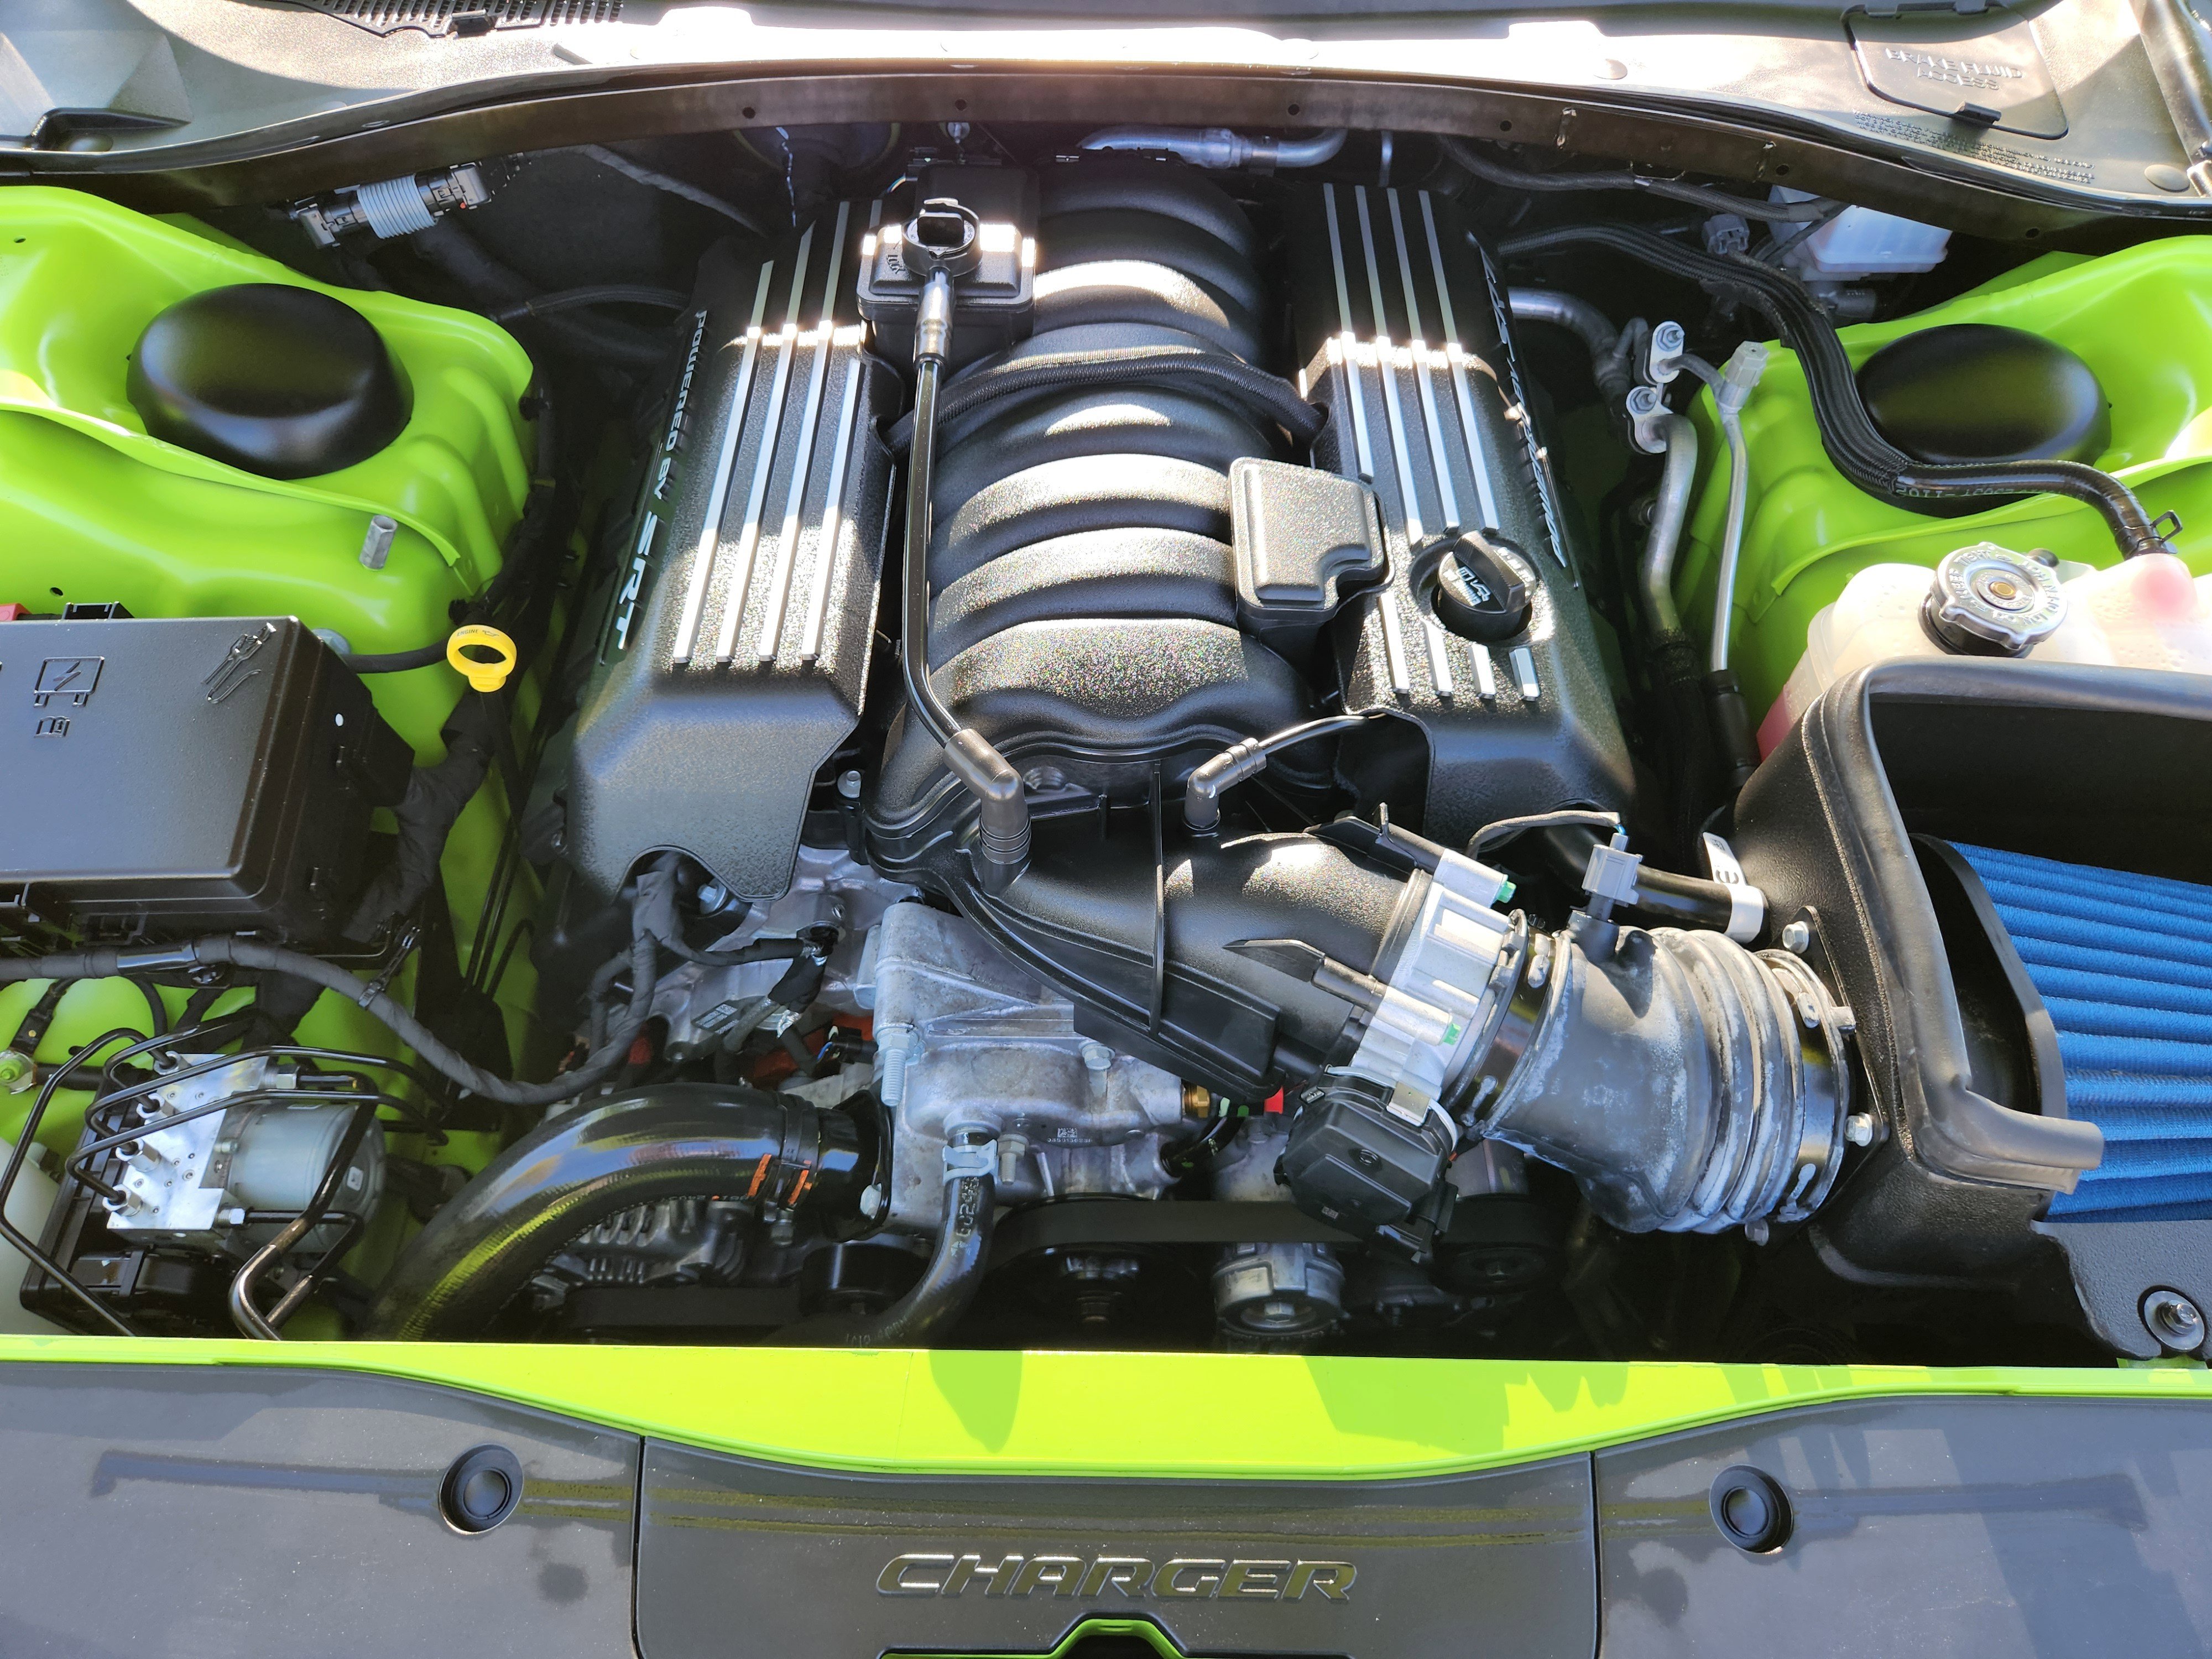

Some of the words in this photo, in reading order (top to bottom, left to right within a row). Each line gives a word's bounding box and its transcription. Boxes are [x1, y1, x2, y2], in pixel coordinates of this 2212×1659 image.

[1885, 48, 1958, 71] BRAKE
[1961, 61, 2024, 79] FLUID
[1917, 67, 2000, 90] ACCESS
[666, 310, 707, 451] POWERED
[654, 457, 671, 499] BY
[615, 511, 657, 650] SRT
[876, 1553, 1358, 1601] CHARGER
